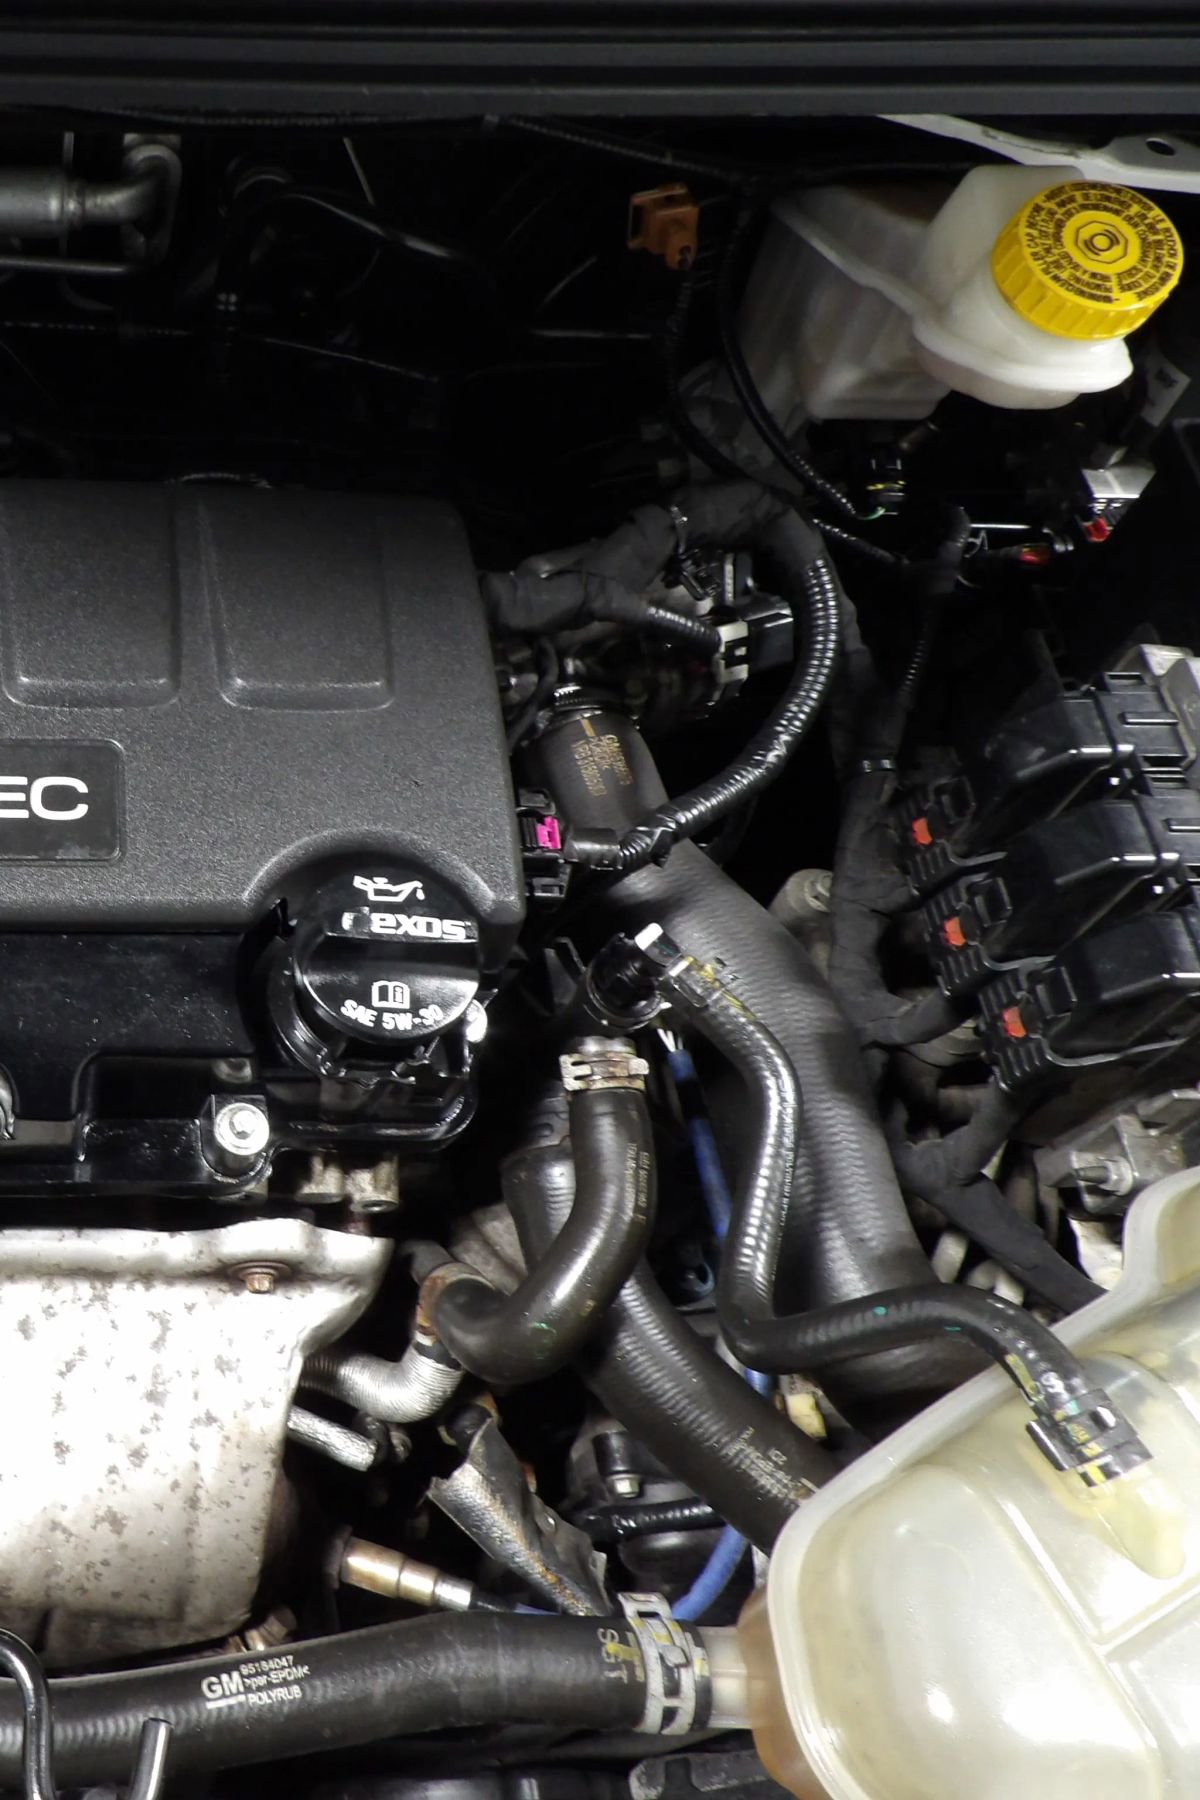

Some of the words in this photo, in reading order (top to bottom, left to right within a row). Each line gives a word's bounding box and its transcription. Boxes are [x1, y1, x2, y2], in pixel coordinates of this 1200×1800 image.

[339, 998, 378, 1027] SAE
[381, 1003, 444, 1030] 5W-30
[202, 1671, 243, 1698] GM
[248, 1685, 302, 1705] POLYRUB
